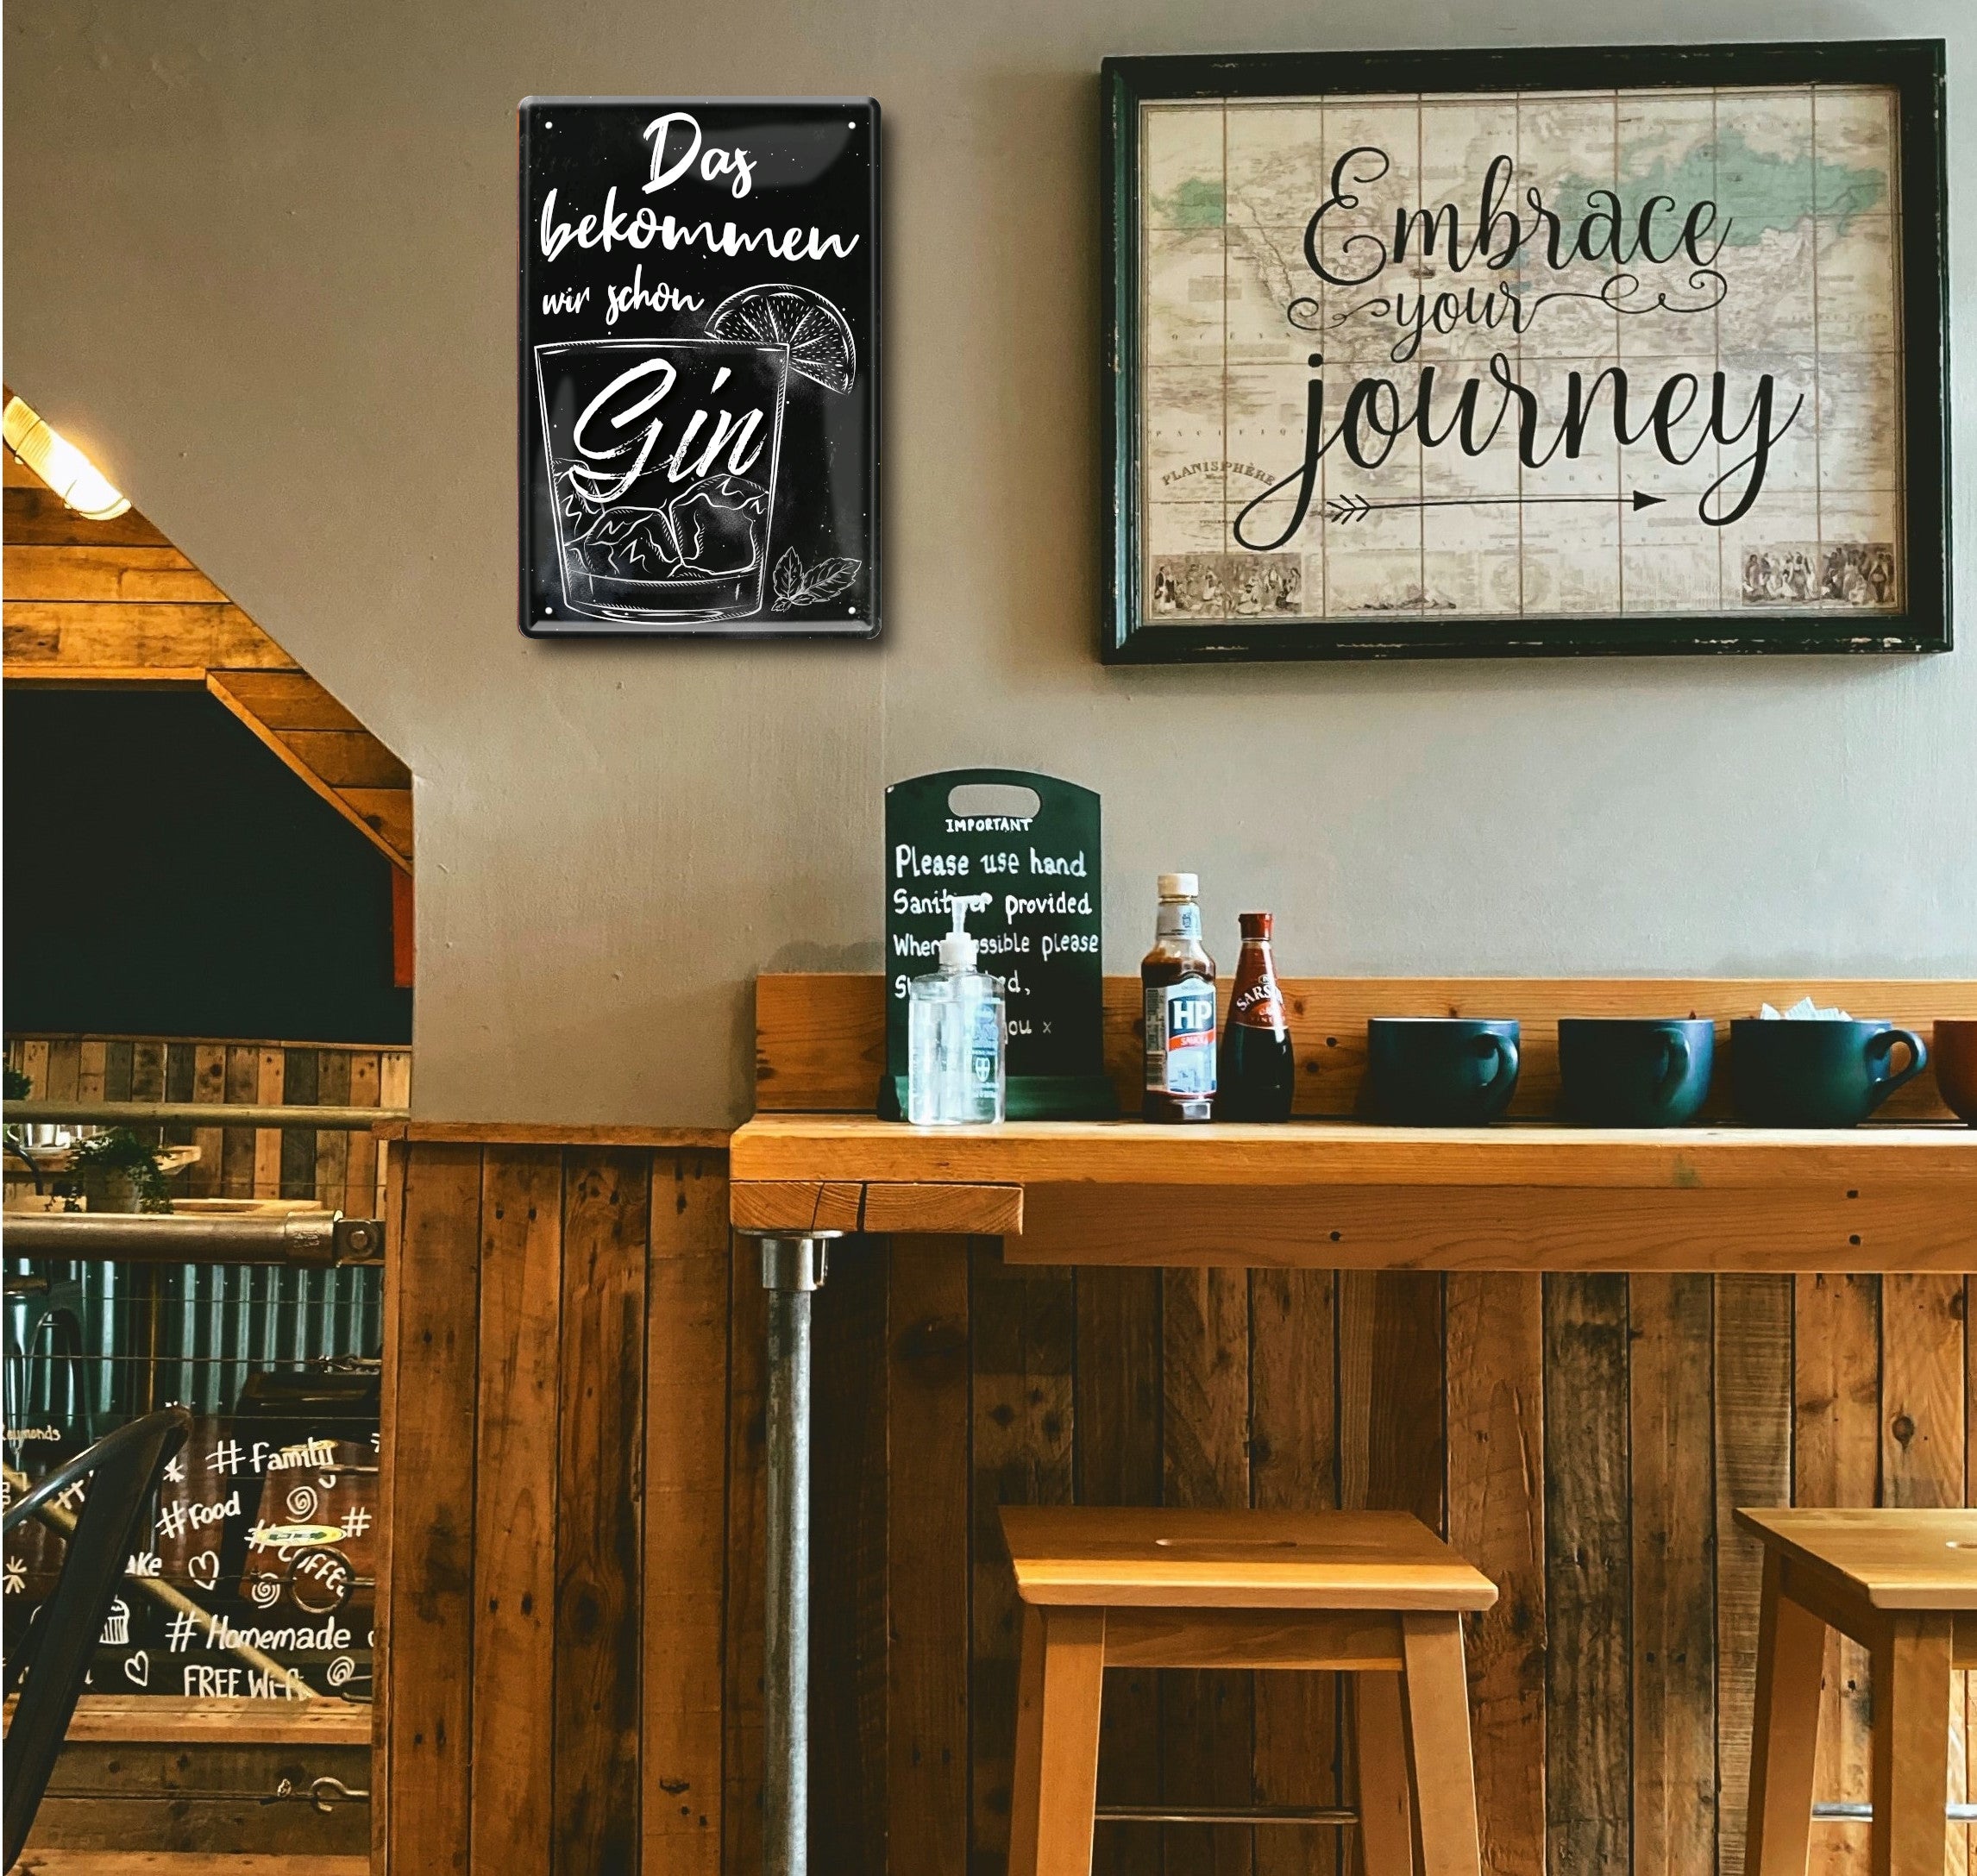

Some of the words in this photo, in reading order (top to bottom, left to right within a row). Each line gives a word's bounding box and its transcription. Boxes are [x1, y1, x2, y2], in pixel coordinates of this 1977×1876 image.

[642, 111, 757, 199] Das
[540, 185, 860, 263] bekommen
[1303, 146, 1732, 286] Embrace
[542, 281, 590, 316] wir
[606, 263, 706, 325] schon
[1390, 281, 1537, 363] your
[568, 358, 764, 504] Gin
[1233, 352, 1804, 552] journey
[945, 817, 1033, 834] IMPORTANT
[894, 844, 970, 879] Please
[980, 852, 1020, 875] use
[1030, 847, 1088, 878] hand
[894, 888, 985, 915] Saniter
[1005, 891, 1093, 925] provided
[1041, 932, 1099, 962] please
[1173, 1000, 1213, 1030] HP
[183, 1664, 242, 1700] FREE
